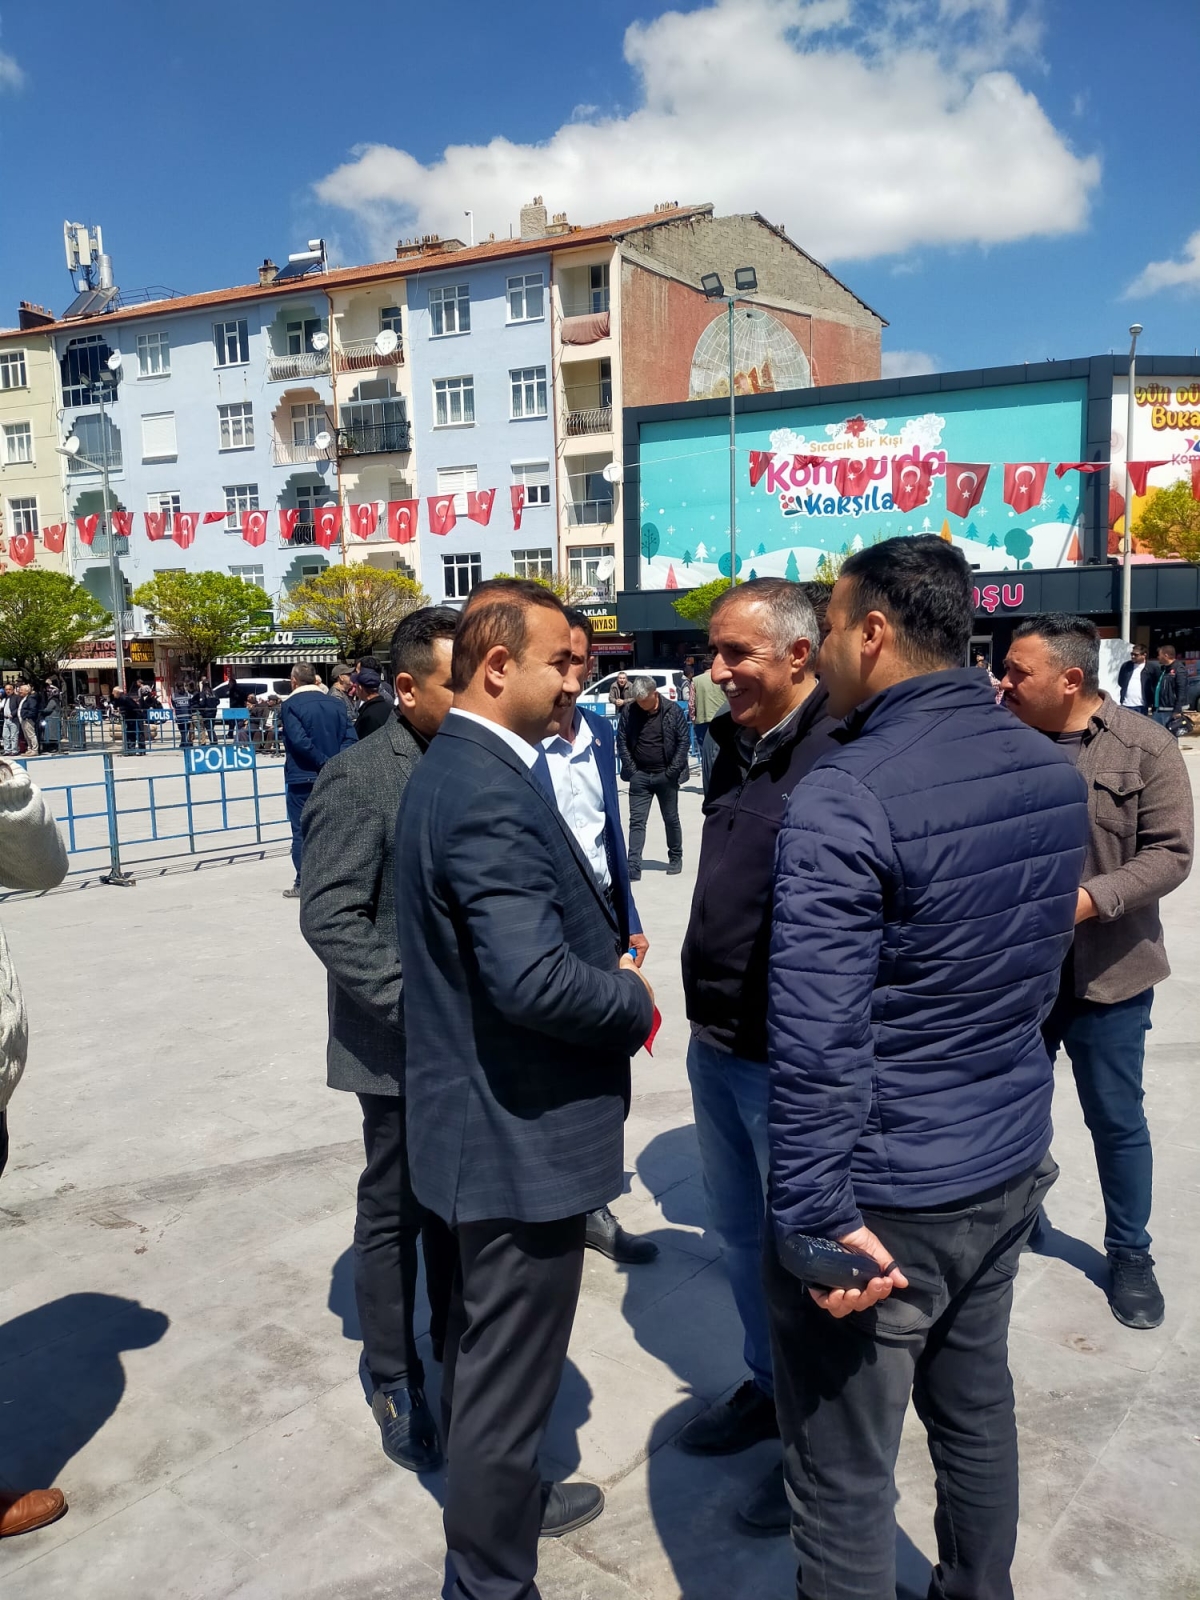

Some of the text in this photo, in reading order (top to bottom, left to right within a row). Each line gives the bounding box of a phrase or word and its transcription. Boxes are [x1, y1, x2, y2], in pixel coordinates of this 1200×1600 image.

[810, 435, 903, 453] Sıcacık Bir Kışı
[577, 608, 608, 618] AKLAR
